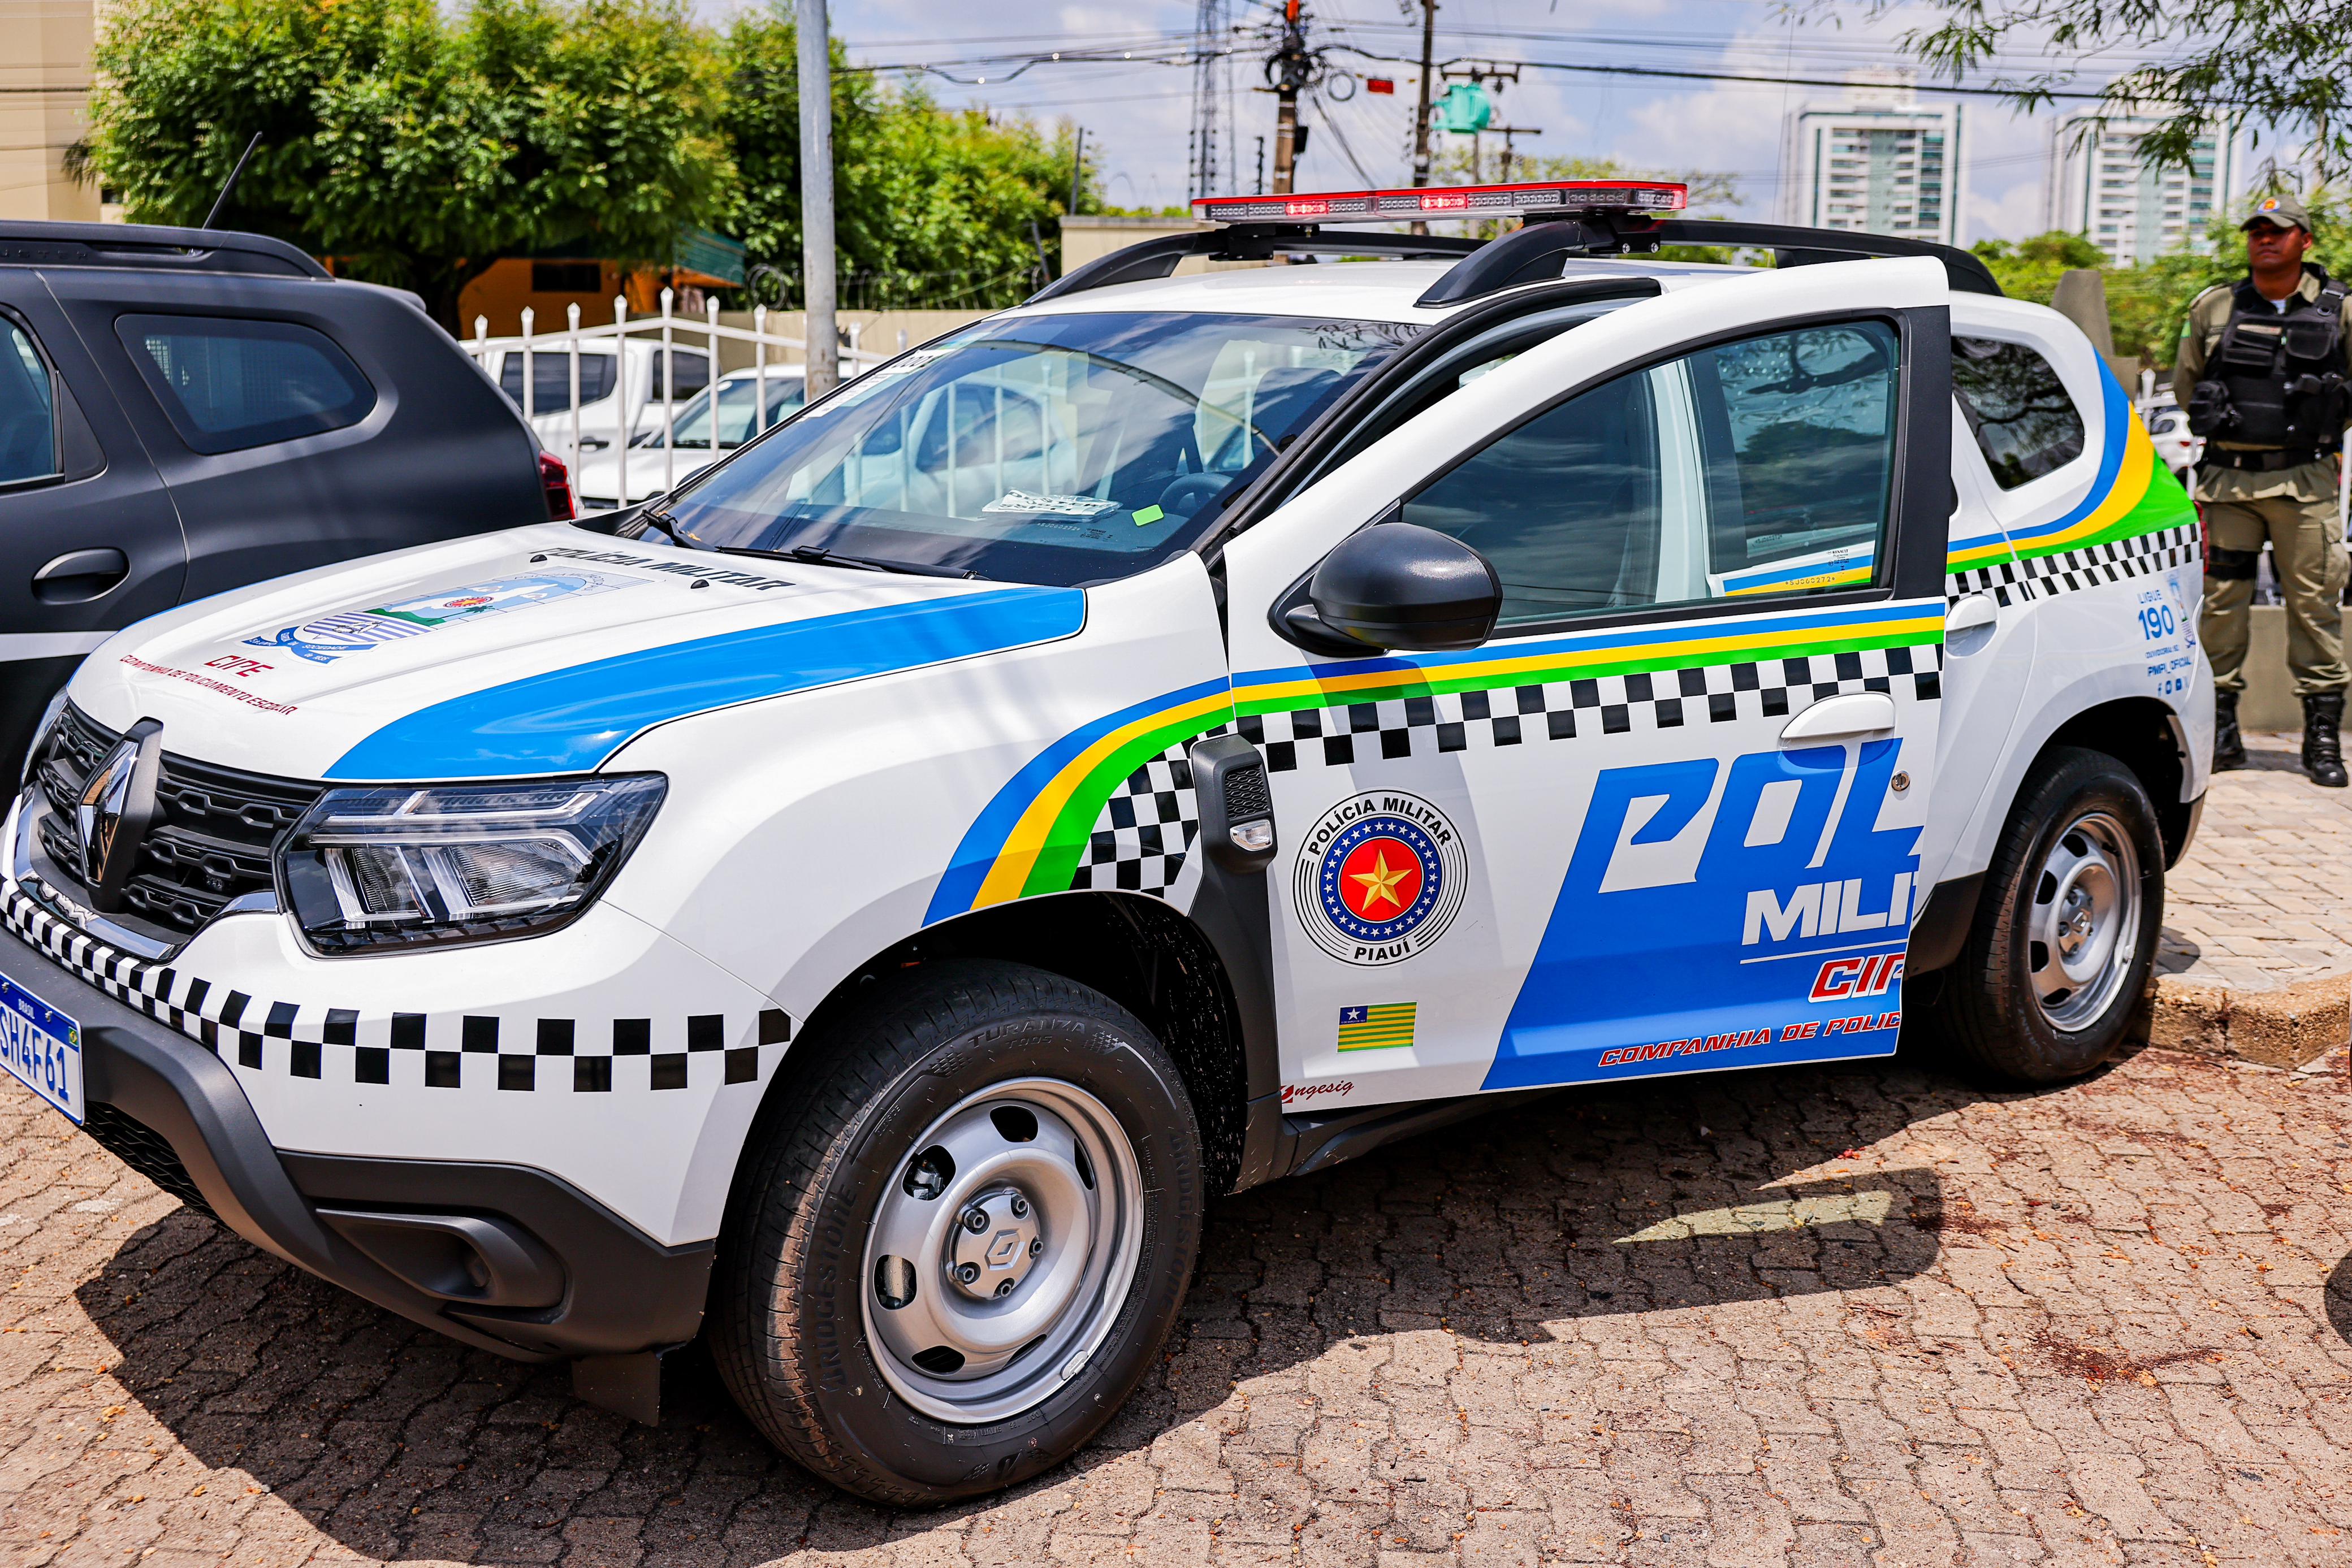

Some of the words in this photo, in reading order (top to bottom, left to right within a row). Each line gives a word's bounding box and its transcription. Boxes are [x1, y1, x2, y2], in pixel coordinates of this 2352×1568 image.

[641, 562, 796, 591] MILITAR
[2138, 604, 2174, 640] 190
[204, 655, 276, 678] CIPE
[119, 654, 174, 675] COMPANHIA
[168, 669, 185, 679] DE
[183, 673, 252, 701] POLICIAMENTO
[249, 697, 299, 716] ESCOLAR
[1307, 798, 1376, 856] POLÍCIA
[1382, 796, 1452, 846] MILITAR
[1741, 870, 1919, 946] MILI
[1354, 937, 1411, 961] PIAUÍ
[18, 998, 36, 1020] BRASIL
[967, 1018, 1086, 1049] TURANZA
[1598, 1028, 1771, 1067] COMPANHIA
[1779, 1021, 1821, 1042] DE
[1822, 1011, 1900, 1037] POLIC
[0, 1005, 70, 1102] SH4F61
